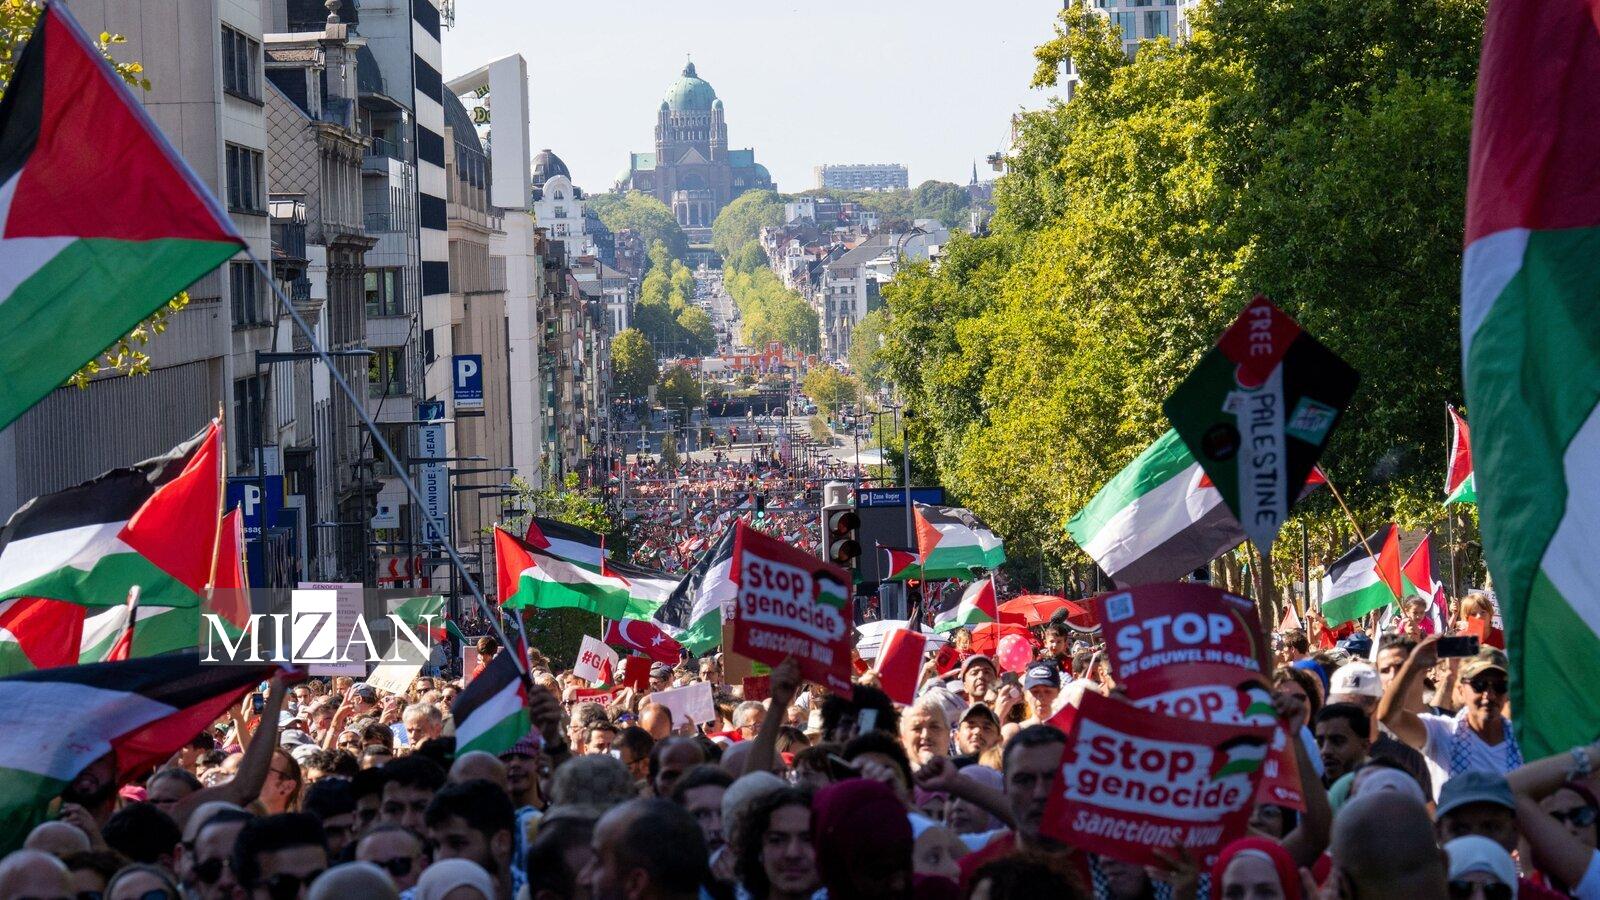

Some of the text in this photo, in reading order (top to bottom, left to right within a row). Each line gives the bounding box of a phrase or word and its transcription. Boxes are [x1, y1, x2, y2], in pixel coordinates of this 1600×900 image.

[1249, 306, 1272, 356] FREE
[458, 359, 478, 387] P
[1251, 393, 1277, 526] PALESTINE
[427, 472, 438, 517] CLINIQUE
[748, 562, 804, 599] Stop
[746, 592, 836, 633] genocide
[1116, 612, 1234, 662] STOP
[1119, 648, 1261, 679] DE GRUWEL IN GAZA
[1088, 735, 1195, 783] Stop
[1077, 768, 1239, 808] genocide
[1072, 809, 1182, 848] sanctions
